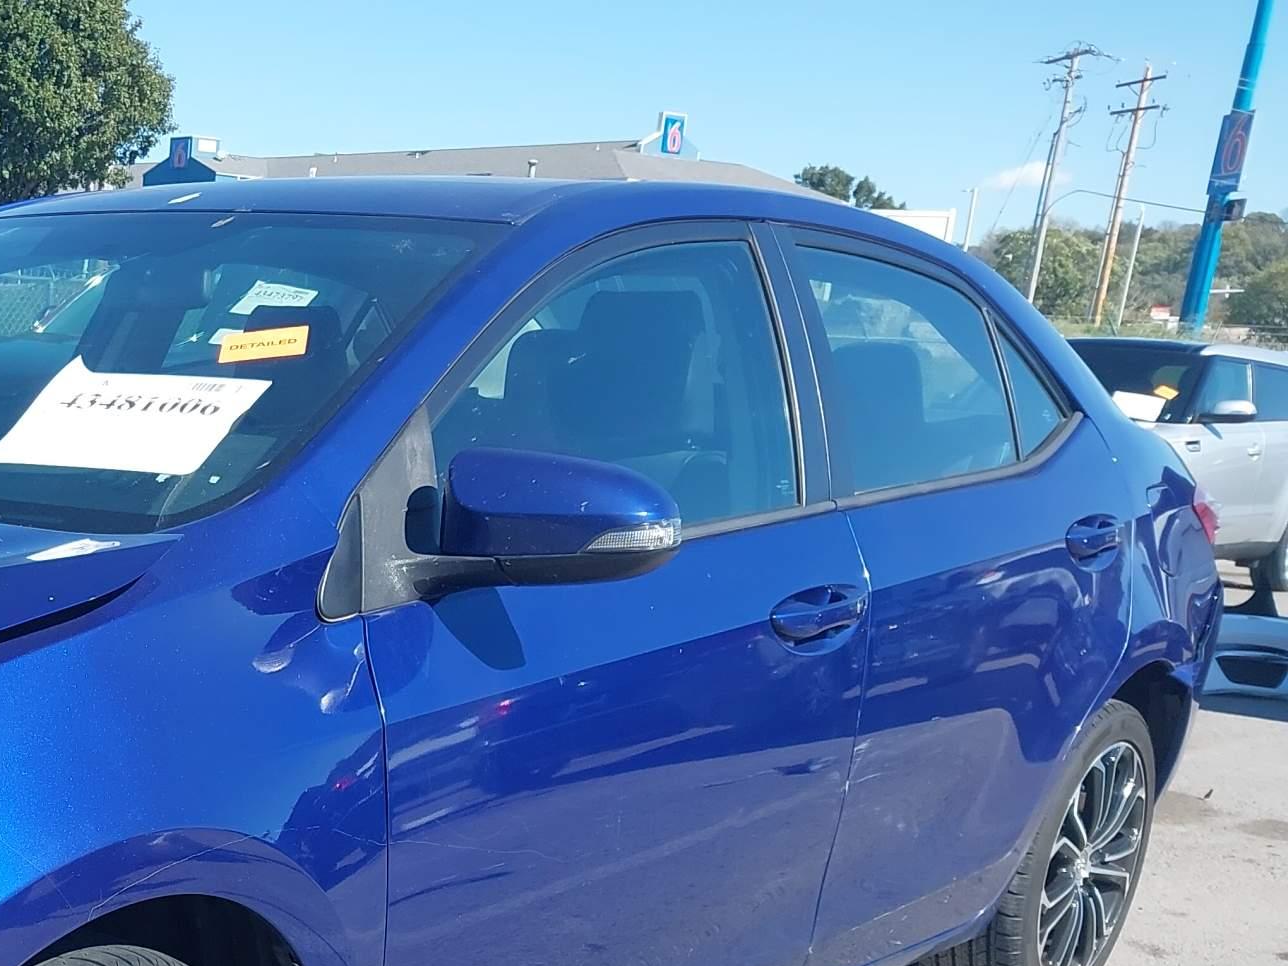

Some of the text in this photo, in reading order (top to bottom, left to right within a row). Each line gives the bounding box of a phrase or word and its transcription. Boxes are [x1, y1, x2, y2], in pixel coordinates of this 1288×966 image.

[668, 121, 681, 152] 6
[1222, 115, 1246, 174] 6
[229, 338, 297, 351] DETAILED
[60, 393, 221, 416] 43481006
